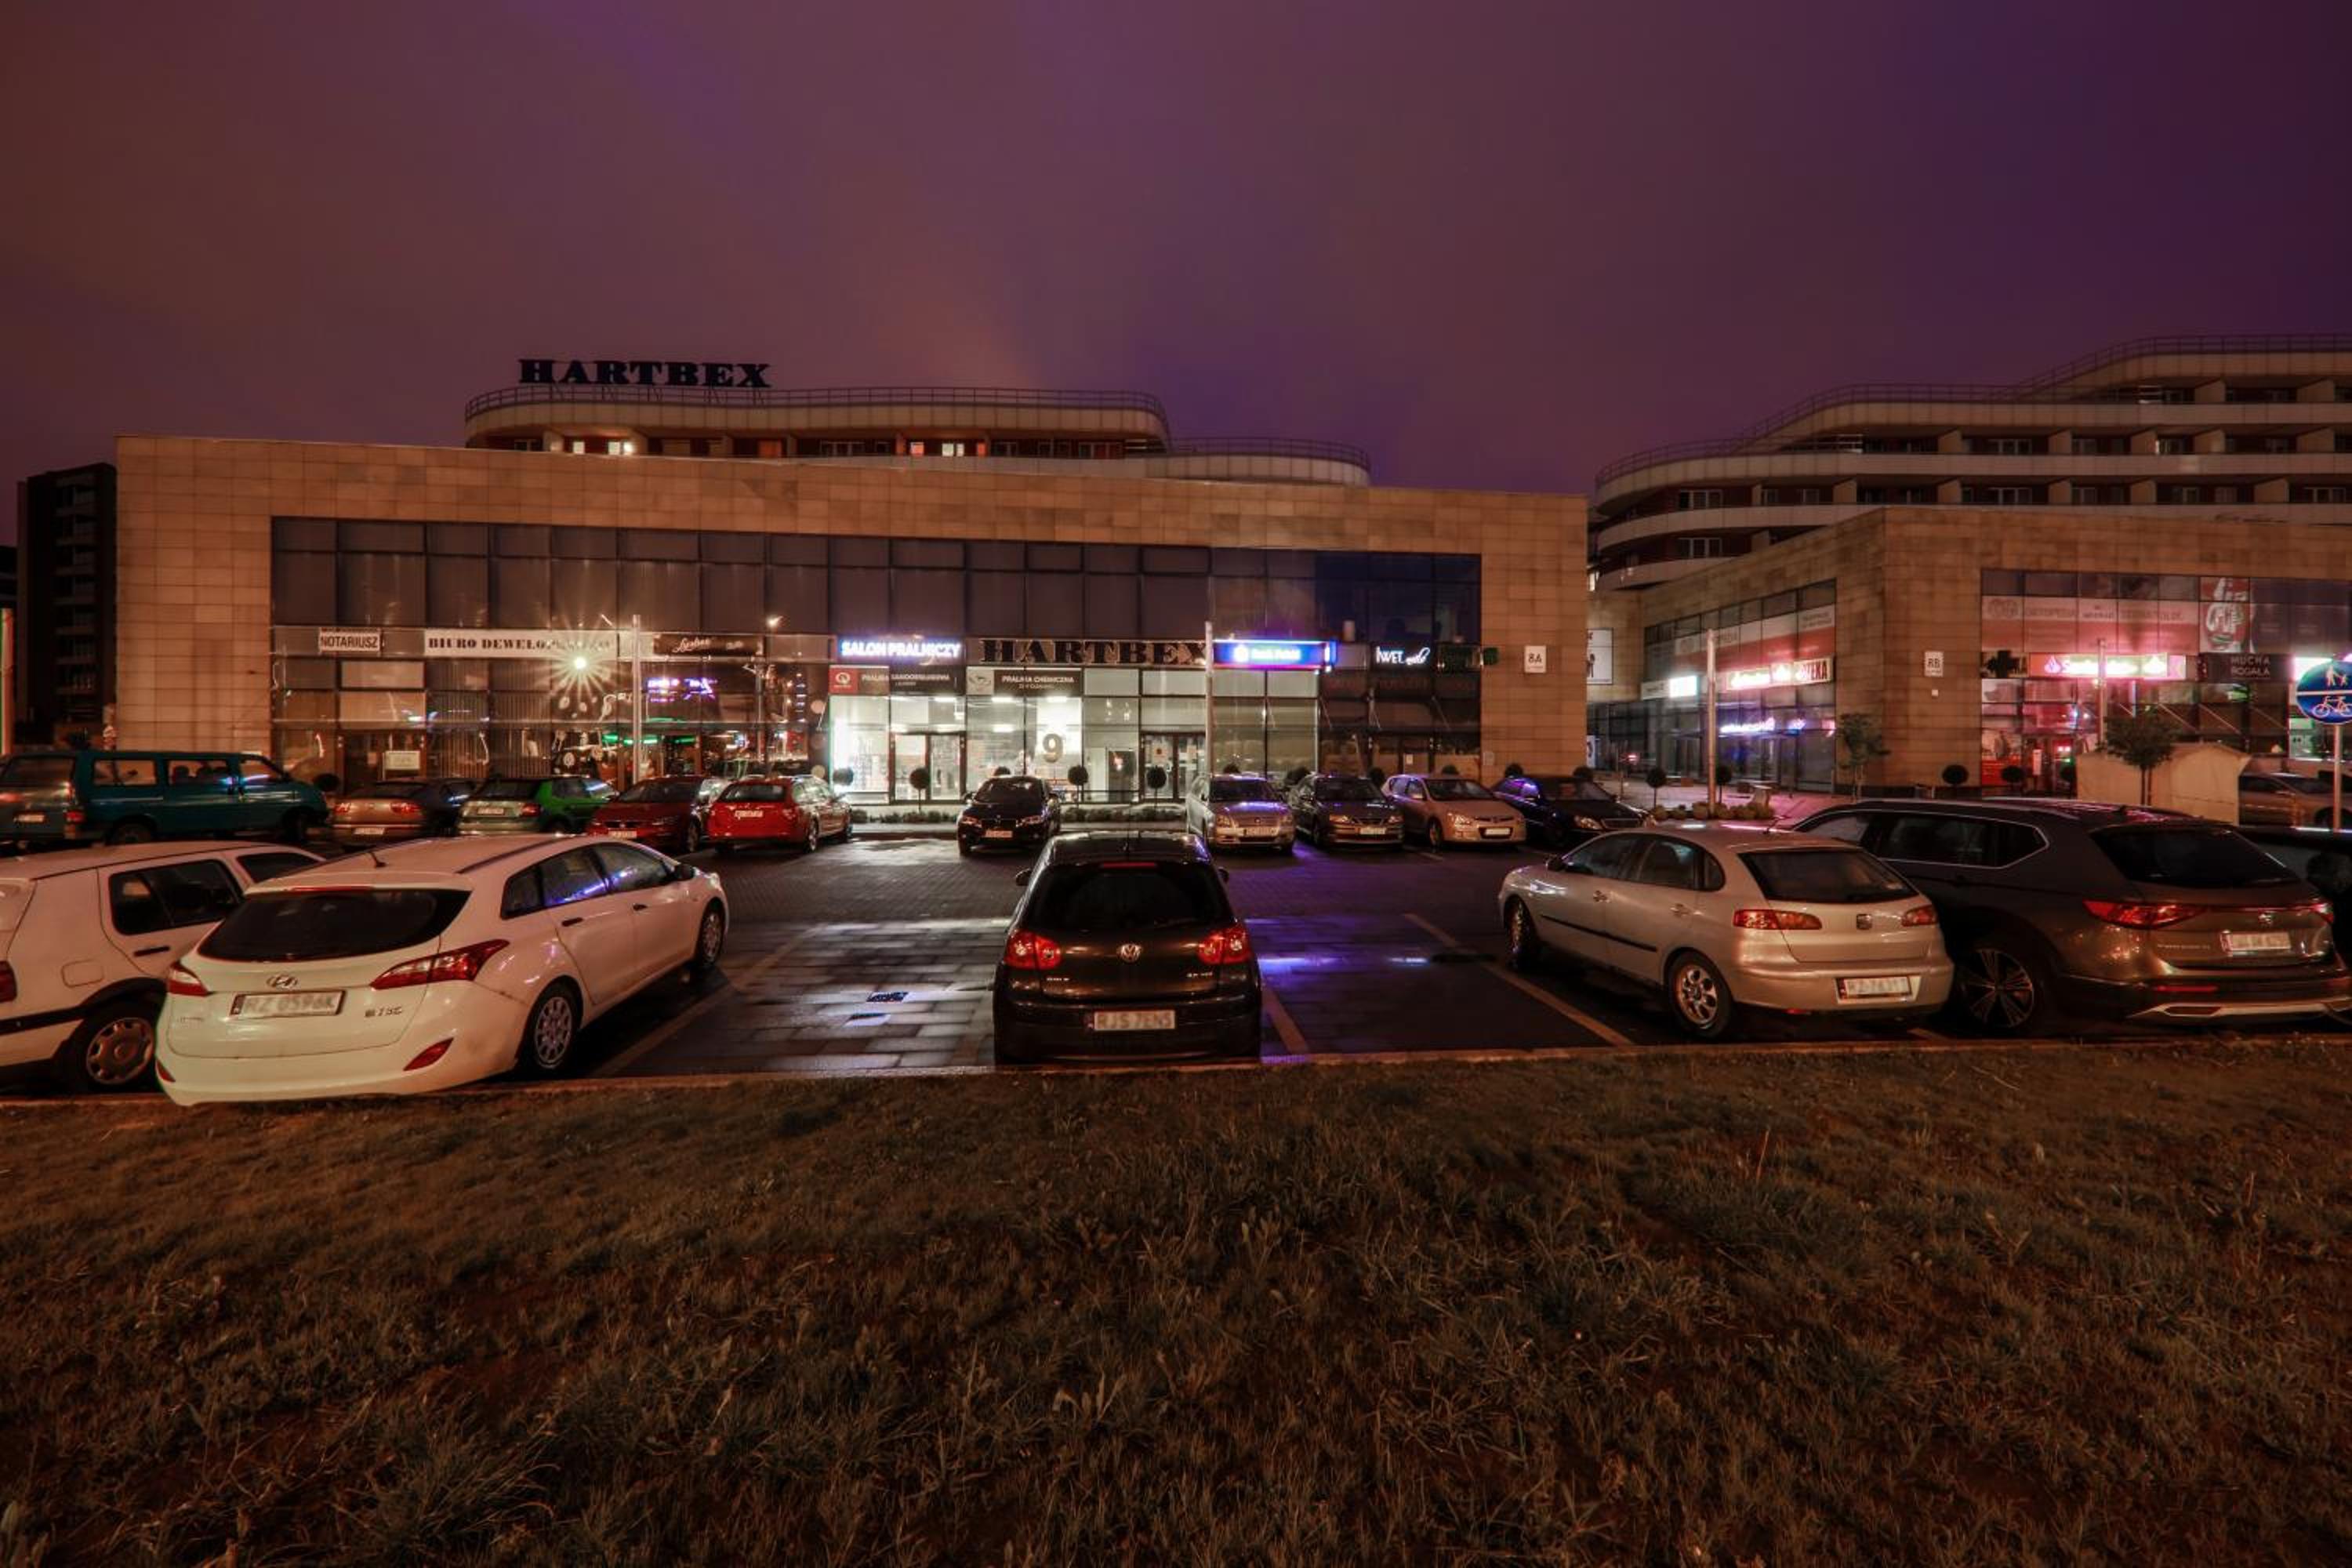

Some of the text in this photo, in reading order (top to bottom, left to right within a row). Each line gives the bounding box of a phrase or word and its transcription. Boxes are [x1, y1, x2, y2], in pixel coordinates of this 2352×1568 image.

[518, 359, 771, 387] HARTBEX
[320, 636, 378, 648] NOTARIUSZ
[428, 637, 477, 648] BIURO
[841, 641, 961, 658] SALON PRALNICZY
[979, 639, 1207, 665] HARTBEX
[2231, 655, 2270, 665] MUCHA
[1043, 733, 1064, 763] 9
